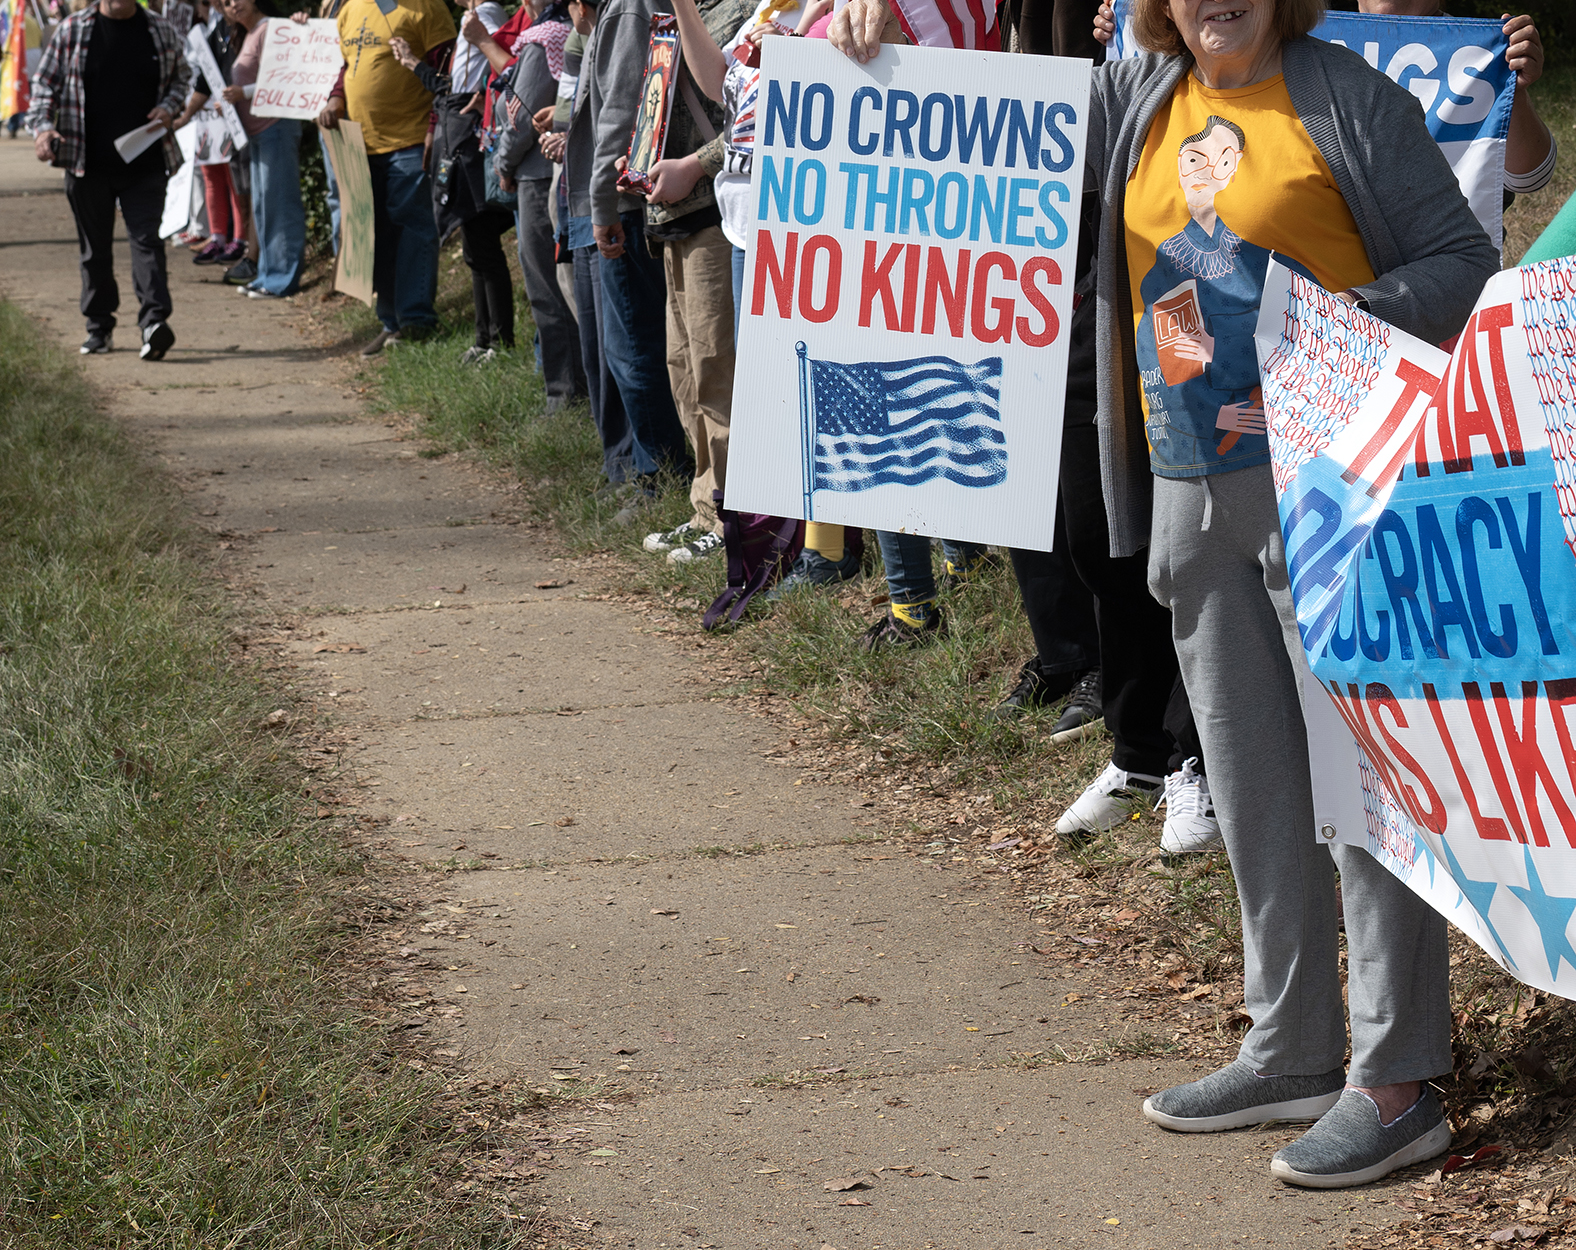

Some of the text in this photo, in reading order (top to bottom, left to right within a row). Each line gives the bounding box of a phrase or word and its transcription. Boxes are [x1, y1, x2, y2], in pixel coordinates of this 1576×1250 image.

[273, 26, 301, 45] So
[342, 36, 382, 48] ORGE
[276, 47, 332, 64] of this
[763, 79, 1077, 173] NO CROWNS
[758, 155, 1072, 250] NO THRONES
[751, 229, 1063, 348] NO KINGS
[1158, 306, 1194, 340] LAW
